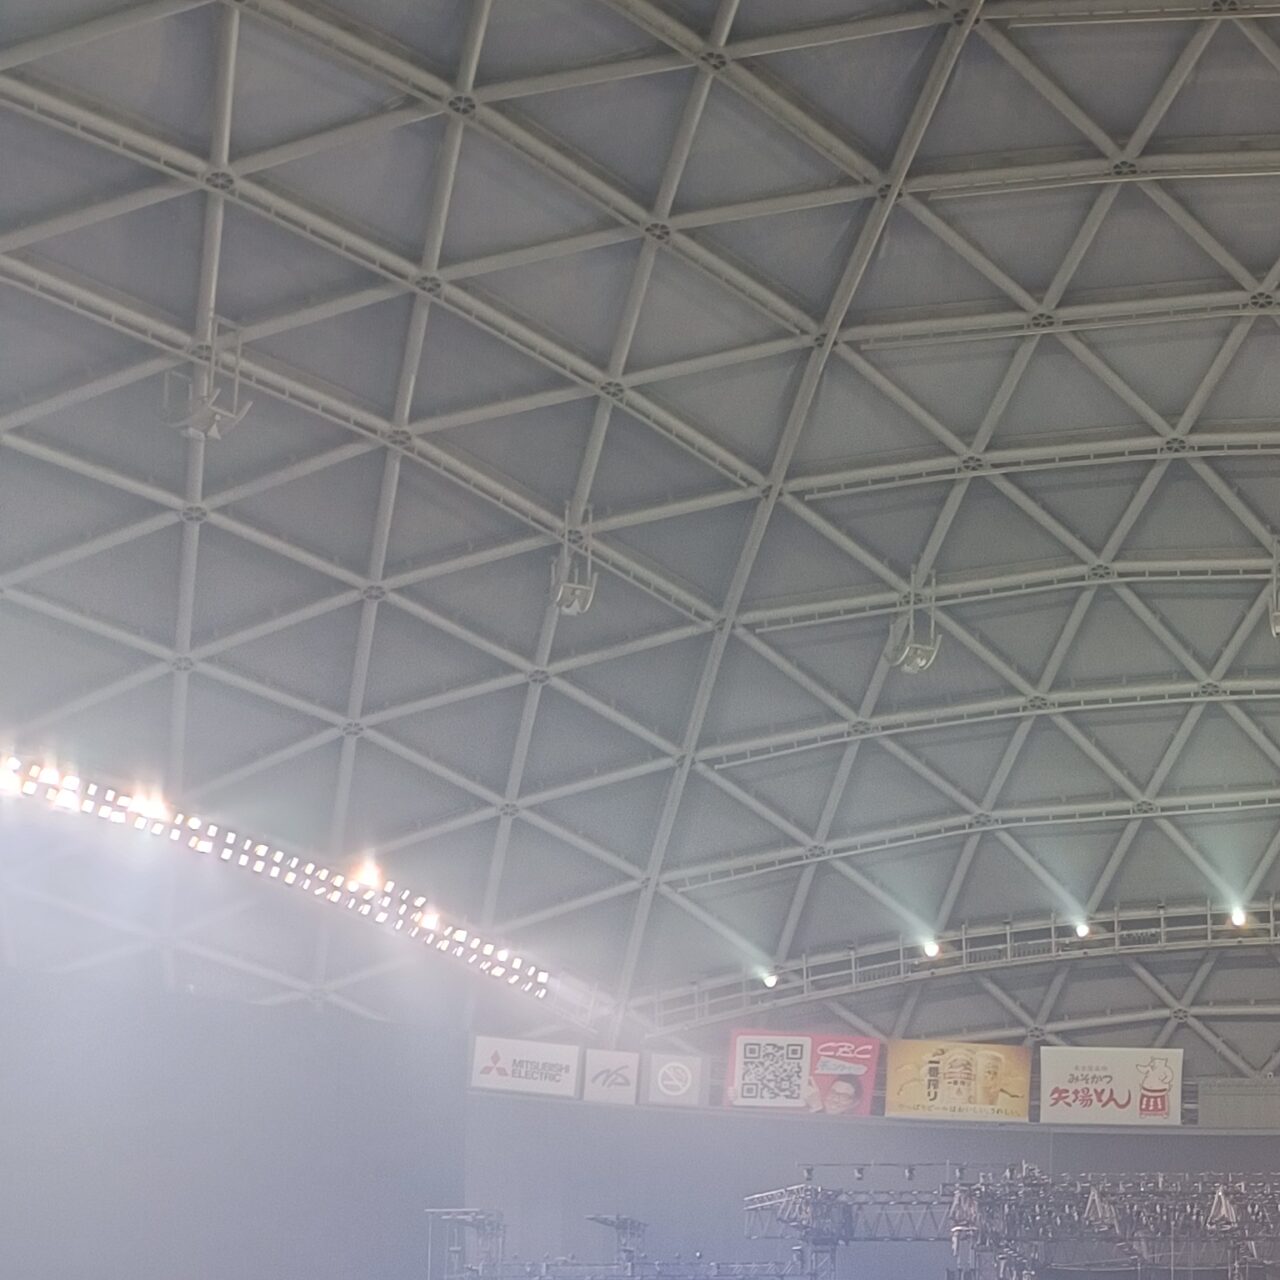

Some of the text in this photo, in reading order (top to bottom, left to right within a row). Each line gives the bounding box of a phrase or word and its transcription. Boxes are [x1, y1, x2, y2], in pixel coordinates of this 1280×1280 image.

[816, 1042, 873, 1059] CBC
[512, 1058, 571, 1074] MITSUBISHI
[511, 1068, 562, 1083] ELECTRIC
[1067, 1073, 1114, 1085] みそかつ
[1049, 1086, 1132, 1109] 矢場とん
